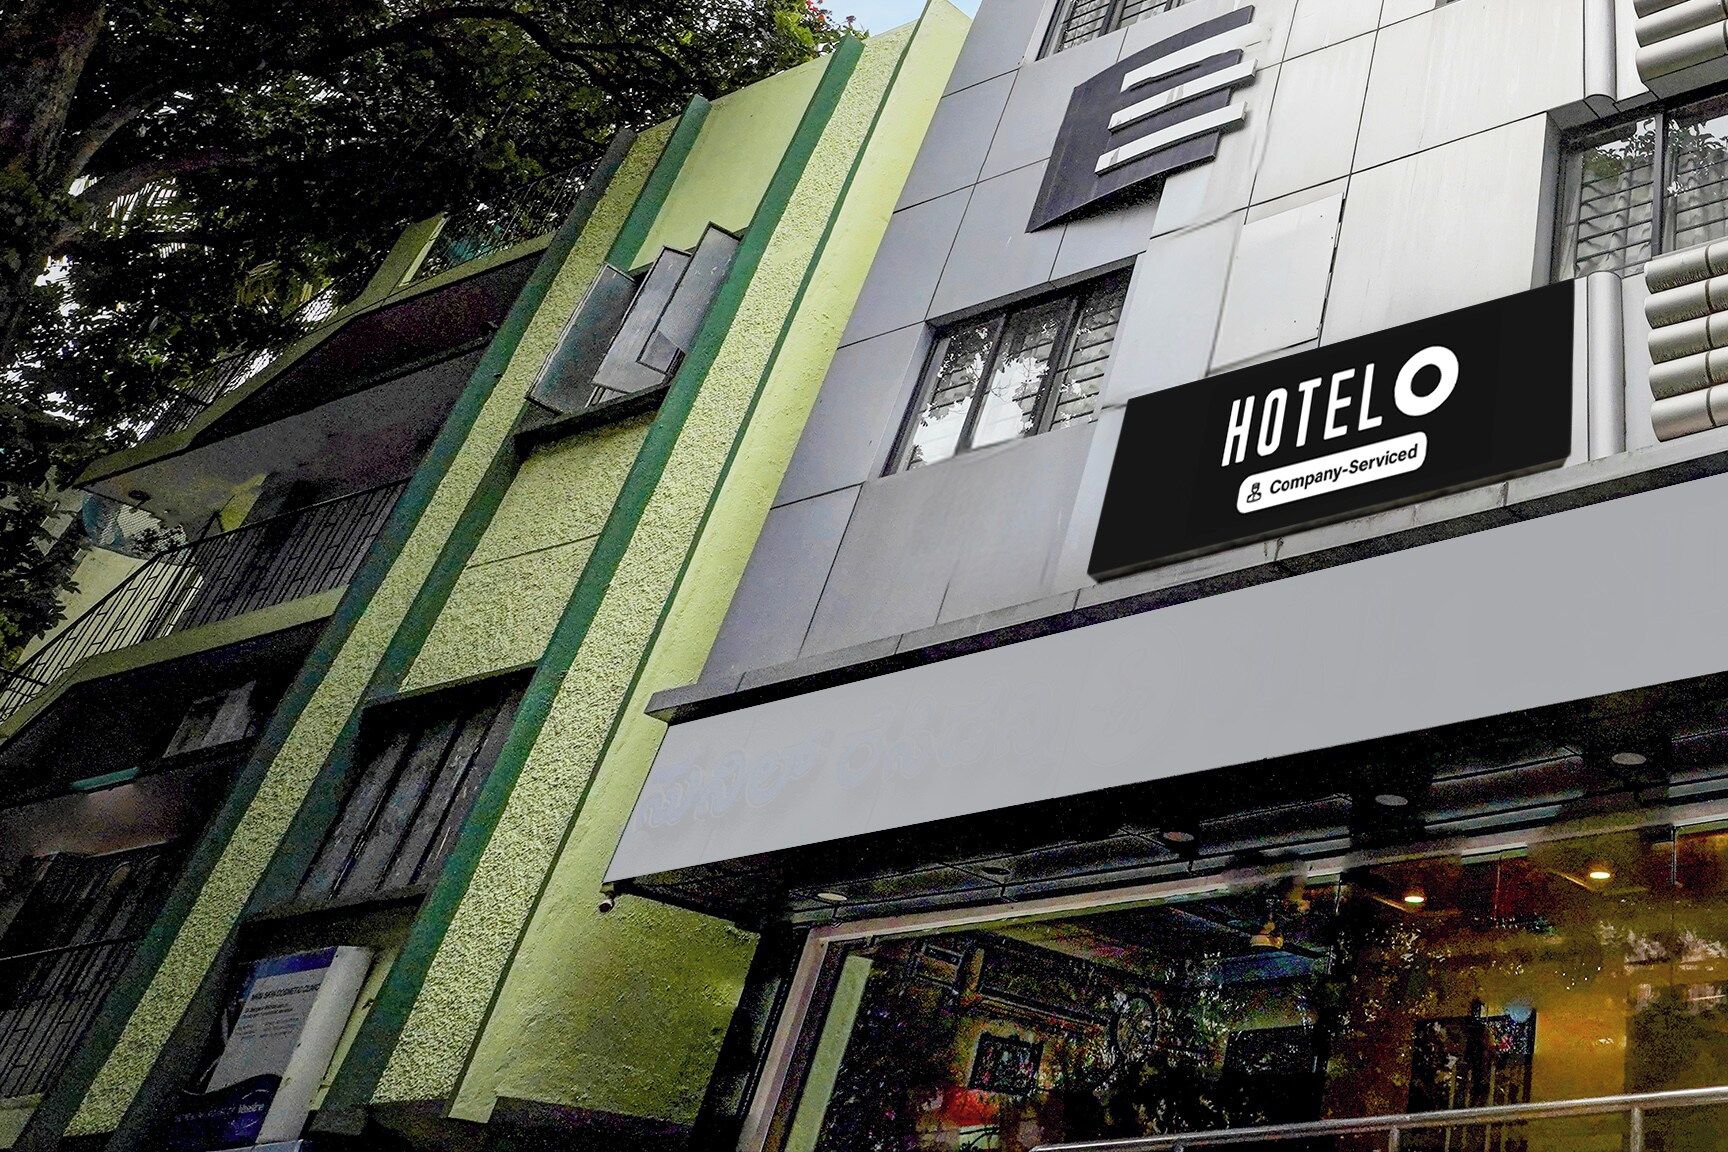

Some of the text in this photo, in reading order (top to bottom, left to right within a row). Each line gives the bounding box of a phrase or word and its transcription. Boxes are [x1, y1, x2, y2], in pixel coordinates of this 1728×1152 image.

[1221, 345, 1460, 467] HOTEL O
[1269, 443, 1419, 495] Company-Serviced
